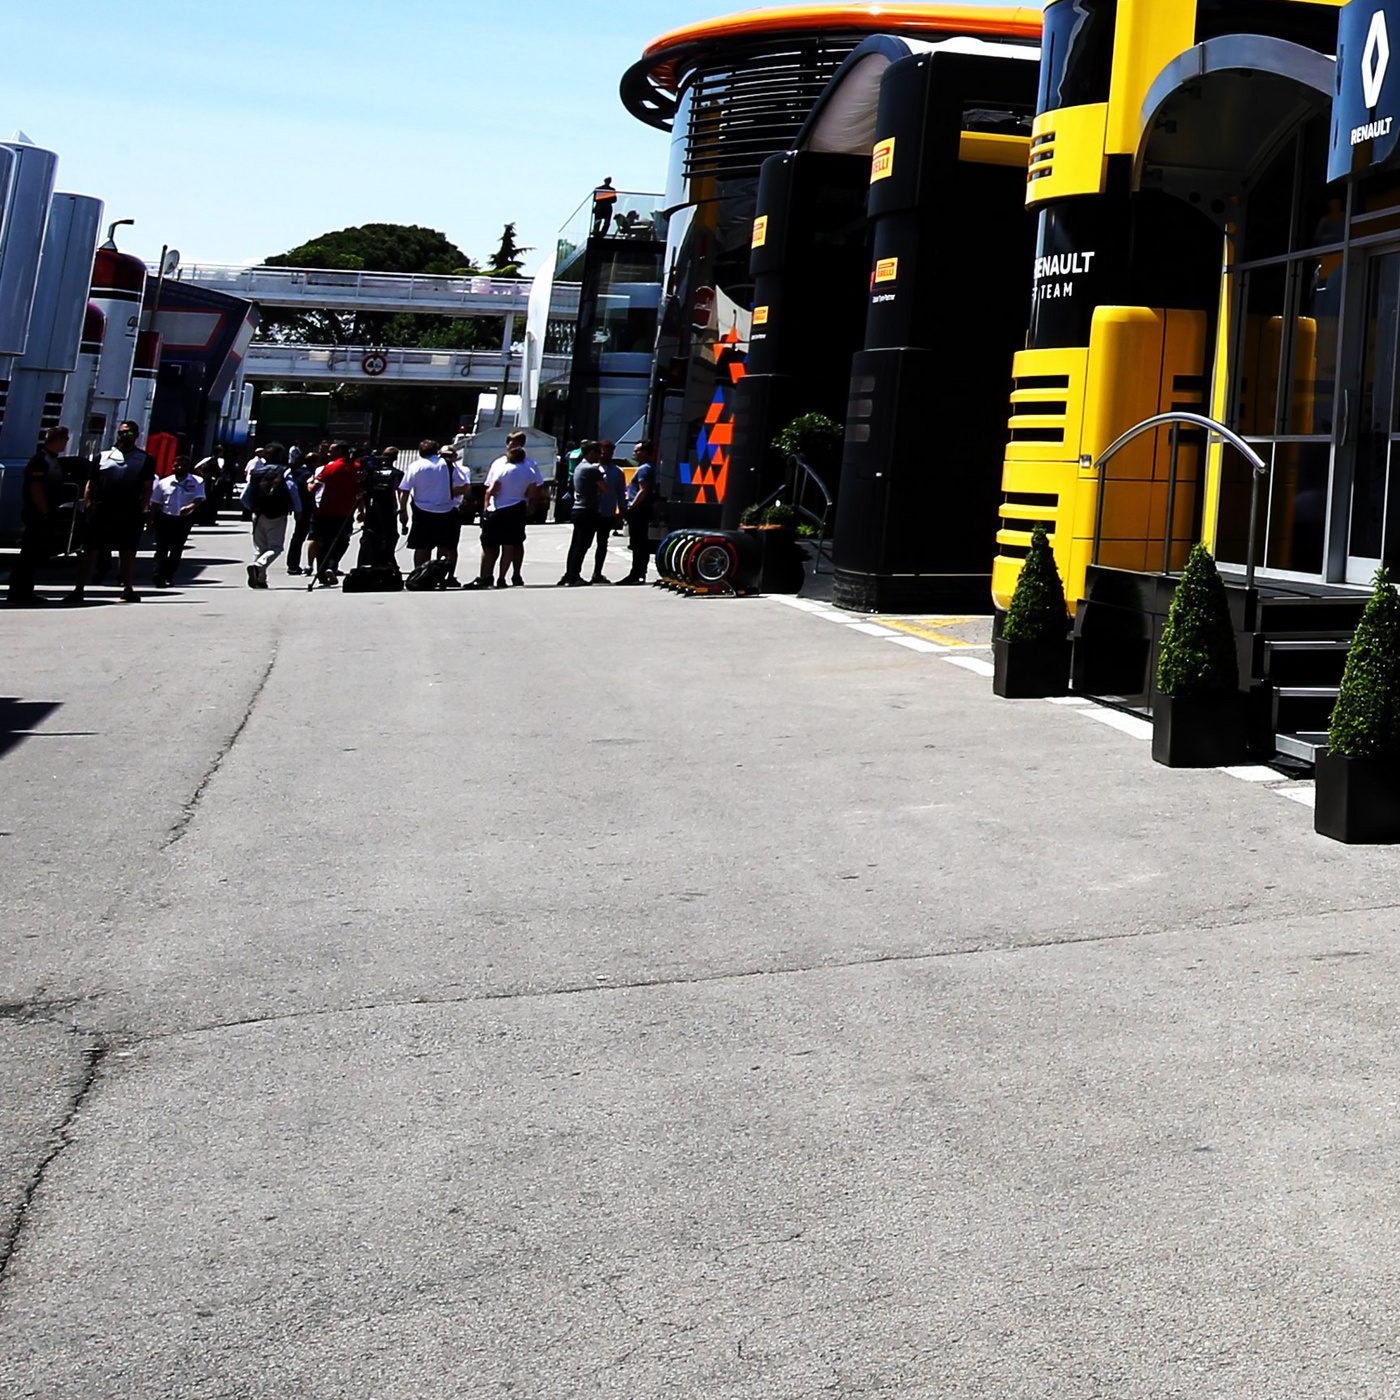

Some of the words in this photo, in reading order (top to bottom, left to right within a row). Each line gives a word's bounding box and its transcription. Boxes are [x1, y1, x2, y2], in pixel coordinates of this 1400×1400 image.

[1350, 116, 1393, 146] RENAULT
[1034, 251, 1095, 280] ENAULT
[1041, 282, 1073, 299] TEAM
